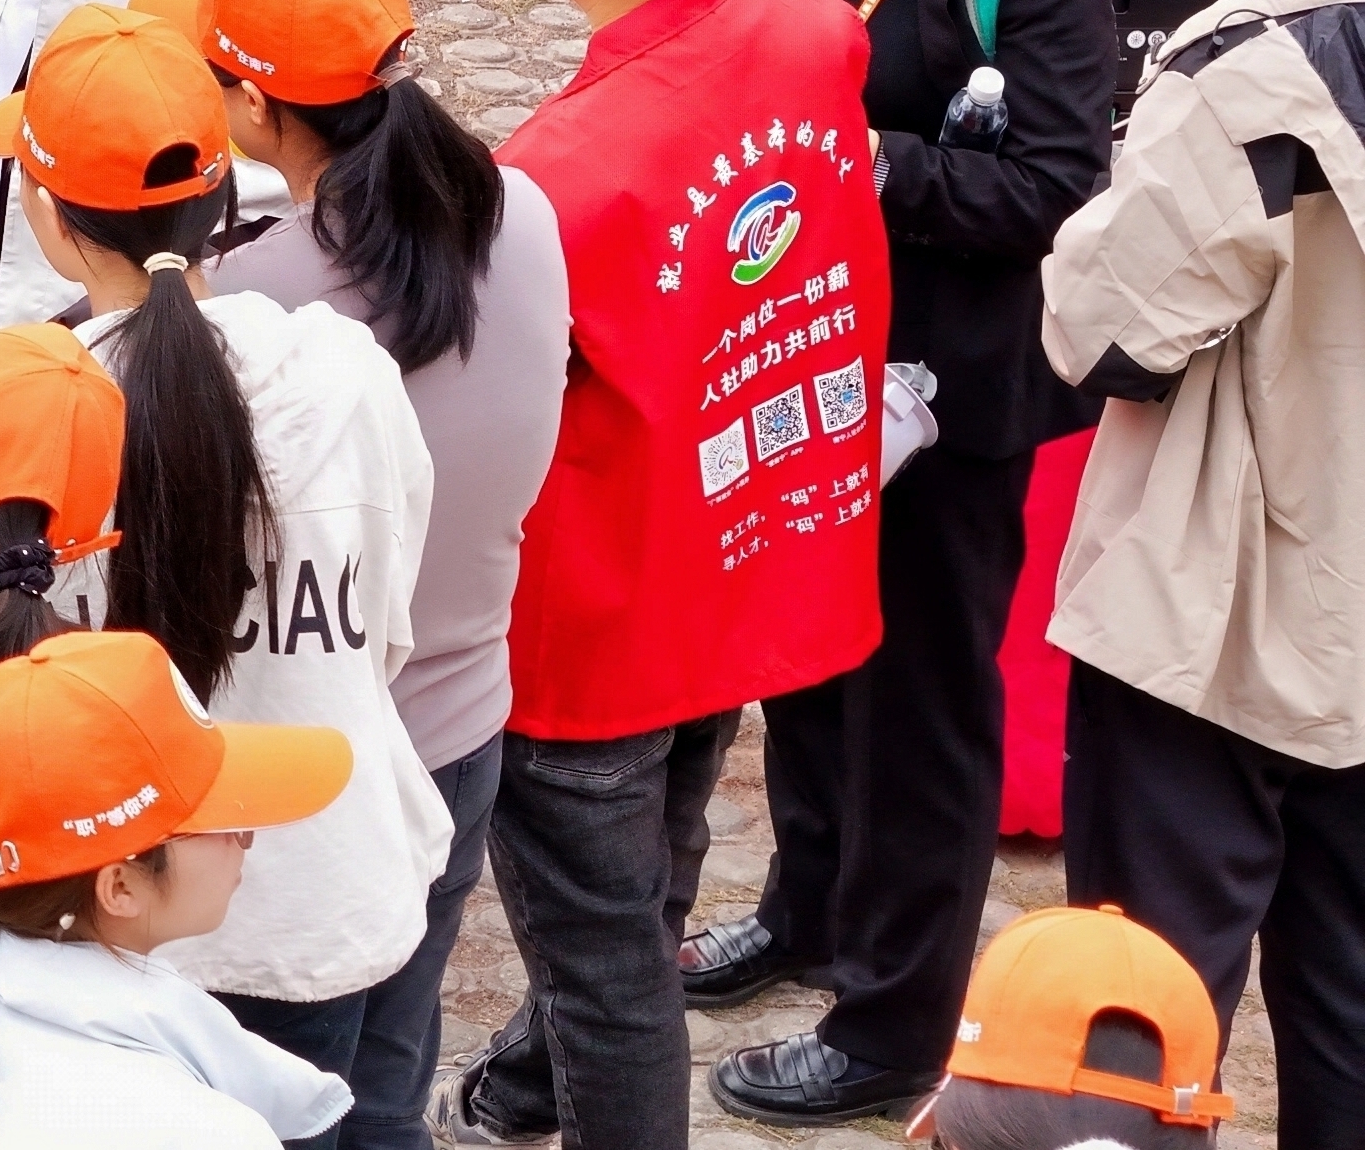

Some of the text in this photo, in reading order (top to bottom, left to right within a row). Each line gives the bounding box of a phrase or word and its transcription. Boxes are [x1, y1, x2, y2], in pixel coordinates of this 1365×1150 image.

[700, 304, 855, 411] 人社助力共前行
[702, 261, 849, 364] 一个岗位一份薪
